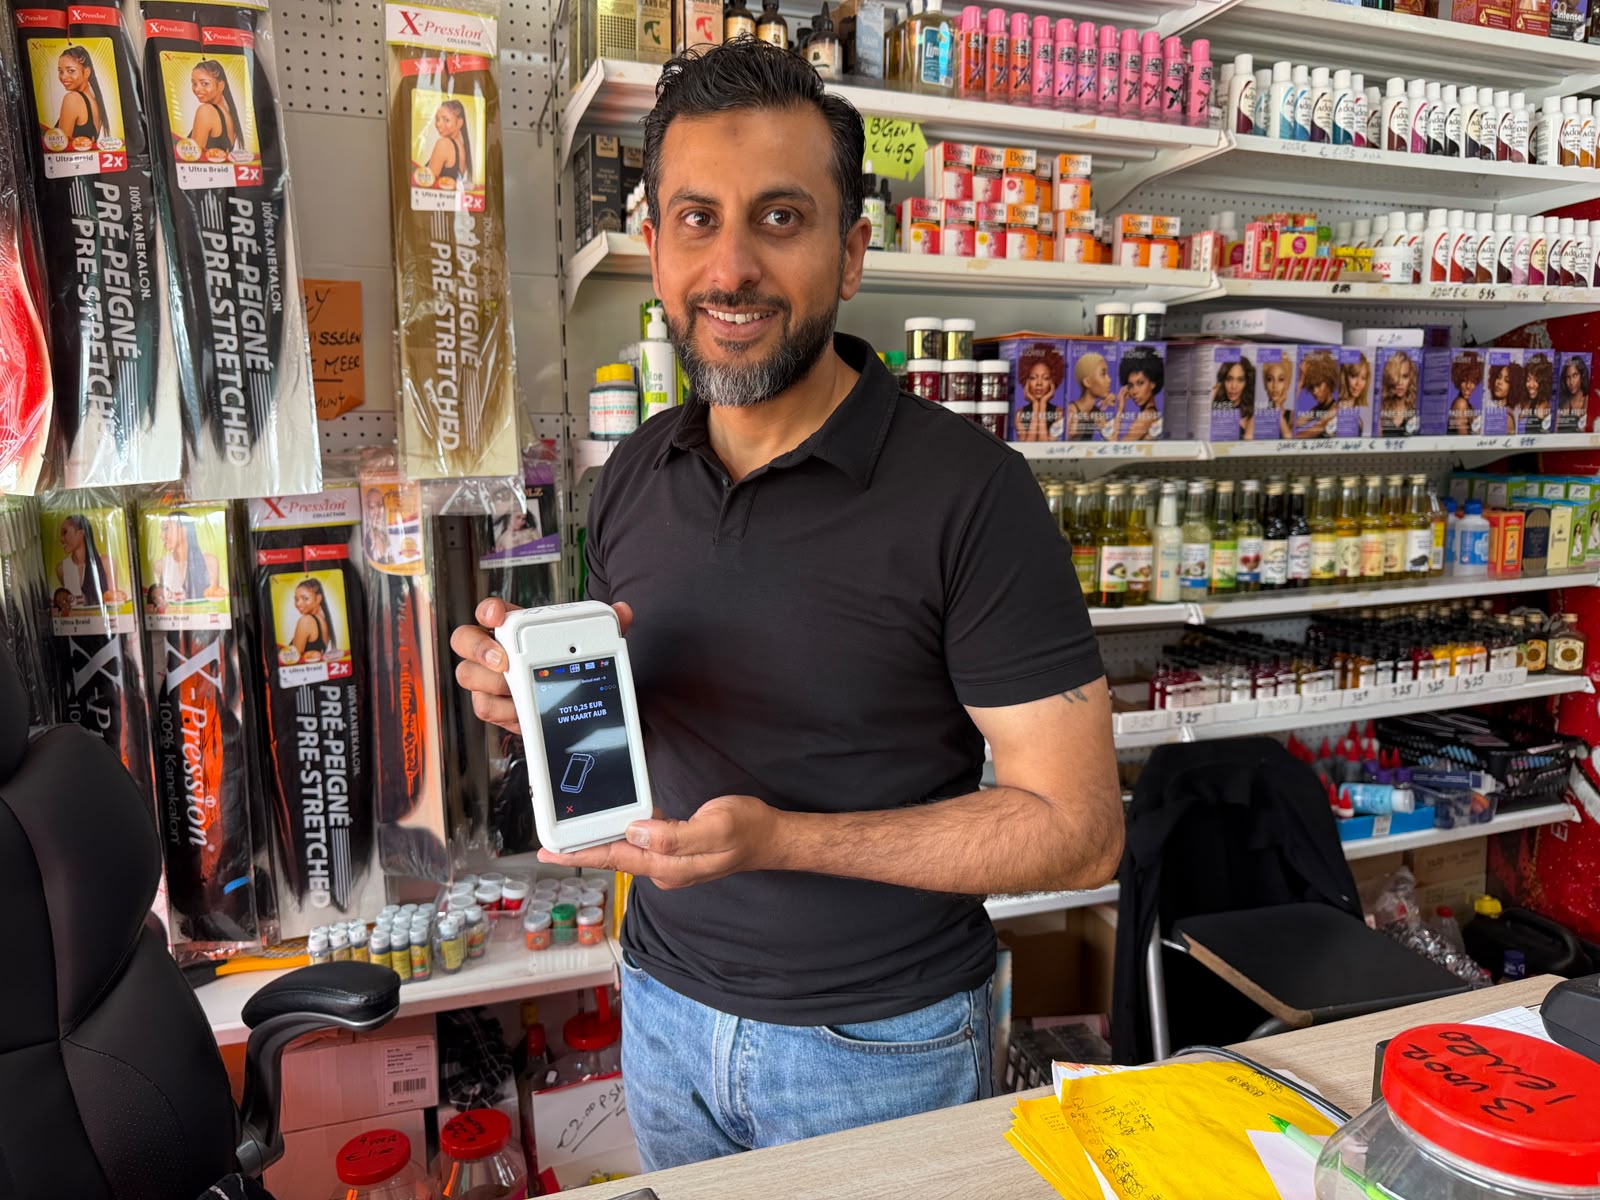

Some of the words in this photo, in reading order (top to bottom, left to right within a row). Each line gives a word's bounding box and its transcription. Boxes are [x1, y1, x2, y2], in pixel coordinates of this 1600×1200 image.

[398, 10, 483, 40] X-Pression
[446, 37, 481, 47] COLLECTION
[885, 143, 916, 164] 4.95
[947, 144, 970, 160] Bigen
[979, 148, 1003, 164] Bigen
[1010, 151, 1033, 166] Bigen
[102, 154, 124, 168] 2x
[1064, 157, 1088, 170] Bigen
[237, 166, 260, 180] 2x
[462, 195, 482, 208] 2x
[915, 200, 938, 215] Bigen
[1012, 207, 1035, 221] Bigen
[1070, 212, 1092, 225] Bigen
[1127, 217, 1149, 230] Bigen
[1155, 218, 1176, 231] Bigen
[131, 213, 151, 300] KANEKALON
[94, 181, 142, 360] PRÉ-PEIGNÉ
[263, 228, 284, 315] KANEKALON
[228, 197, 274, 372] PRÉ-PEIGNÉ
[202, 231, 250, 467] PRE-STRETCHED
[430, 241, 460, 450] PRE-STRETCHED
[324, 355, 360, 375] MEER
[263, 495, 347, 521] X-Pression
[312, 511, 346, 519] COLLECTION
[329, 662, 349, 676] 2x
[559, 706, 572, 714] TOT
[574, 703, 588, 713] 0,25
[589, 700, 603, 708] EUR
[159, 702, 175, 747] 100%
[557, 716, 569, 724] UW
[570, 712, 592, 722] KAART
[593, 709, 607, 717] AUB
[164, 636, 225, 848] X-Pression
[319, 685, 353, 829] PRÉ-PEIGNÉ
[164, 753, 182, 844] Kanekalon
[296, 715, 331, 909] PRE-STRETCHED
[1480, 1097, 1535, 1122] 3
